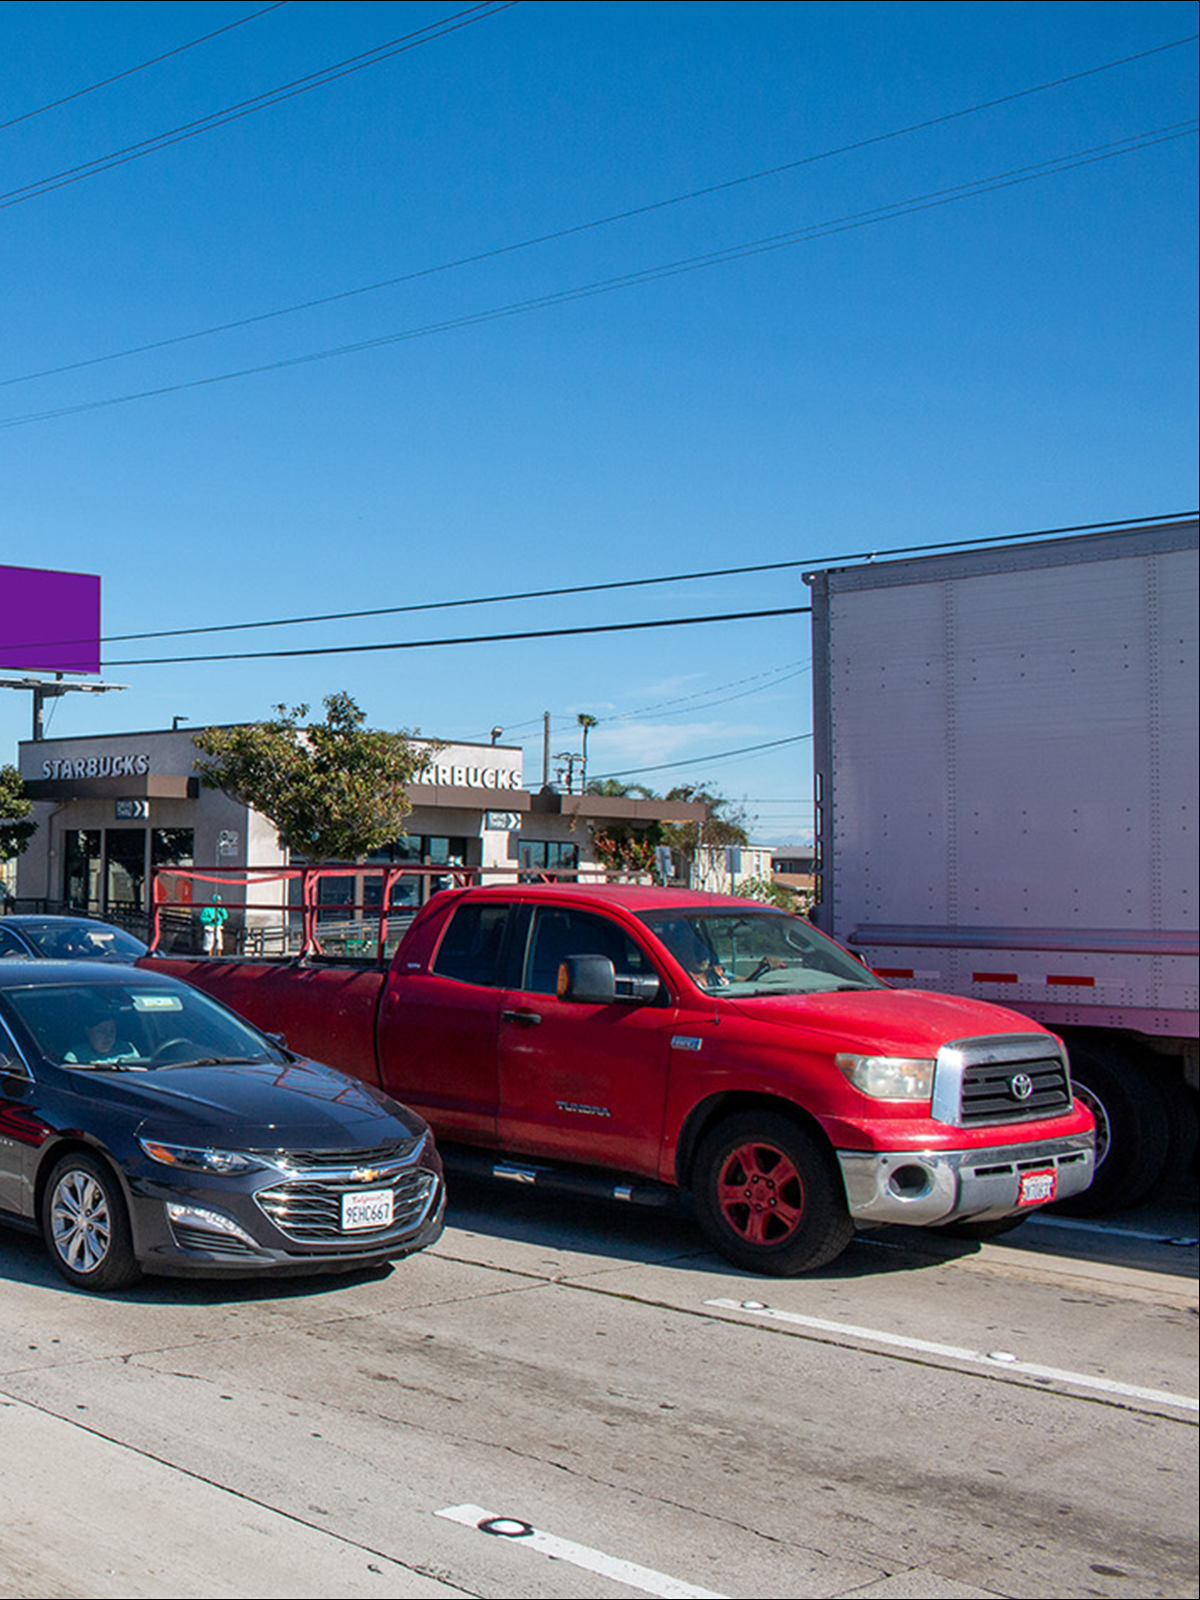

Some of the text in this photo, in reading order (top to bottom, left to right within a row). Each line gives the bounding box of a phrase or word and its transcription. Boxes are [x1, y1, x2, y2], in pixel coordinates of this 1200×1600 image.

[42, 755, 148, 779] STARBUCKS
[556, 1101, 611, 1117] TUNDRA
[345, 1203, 389, 1224] 9EHC667
